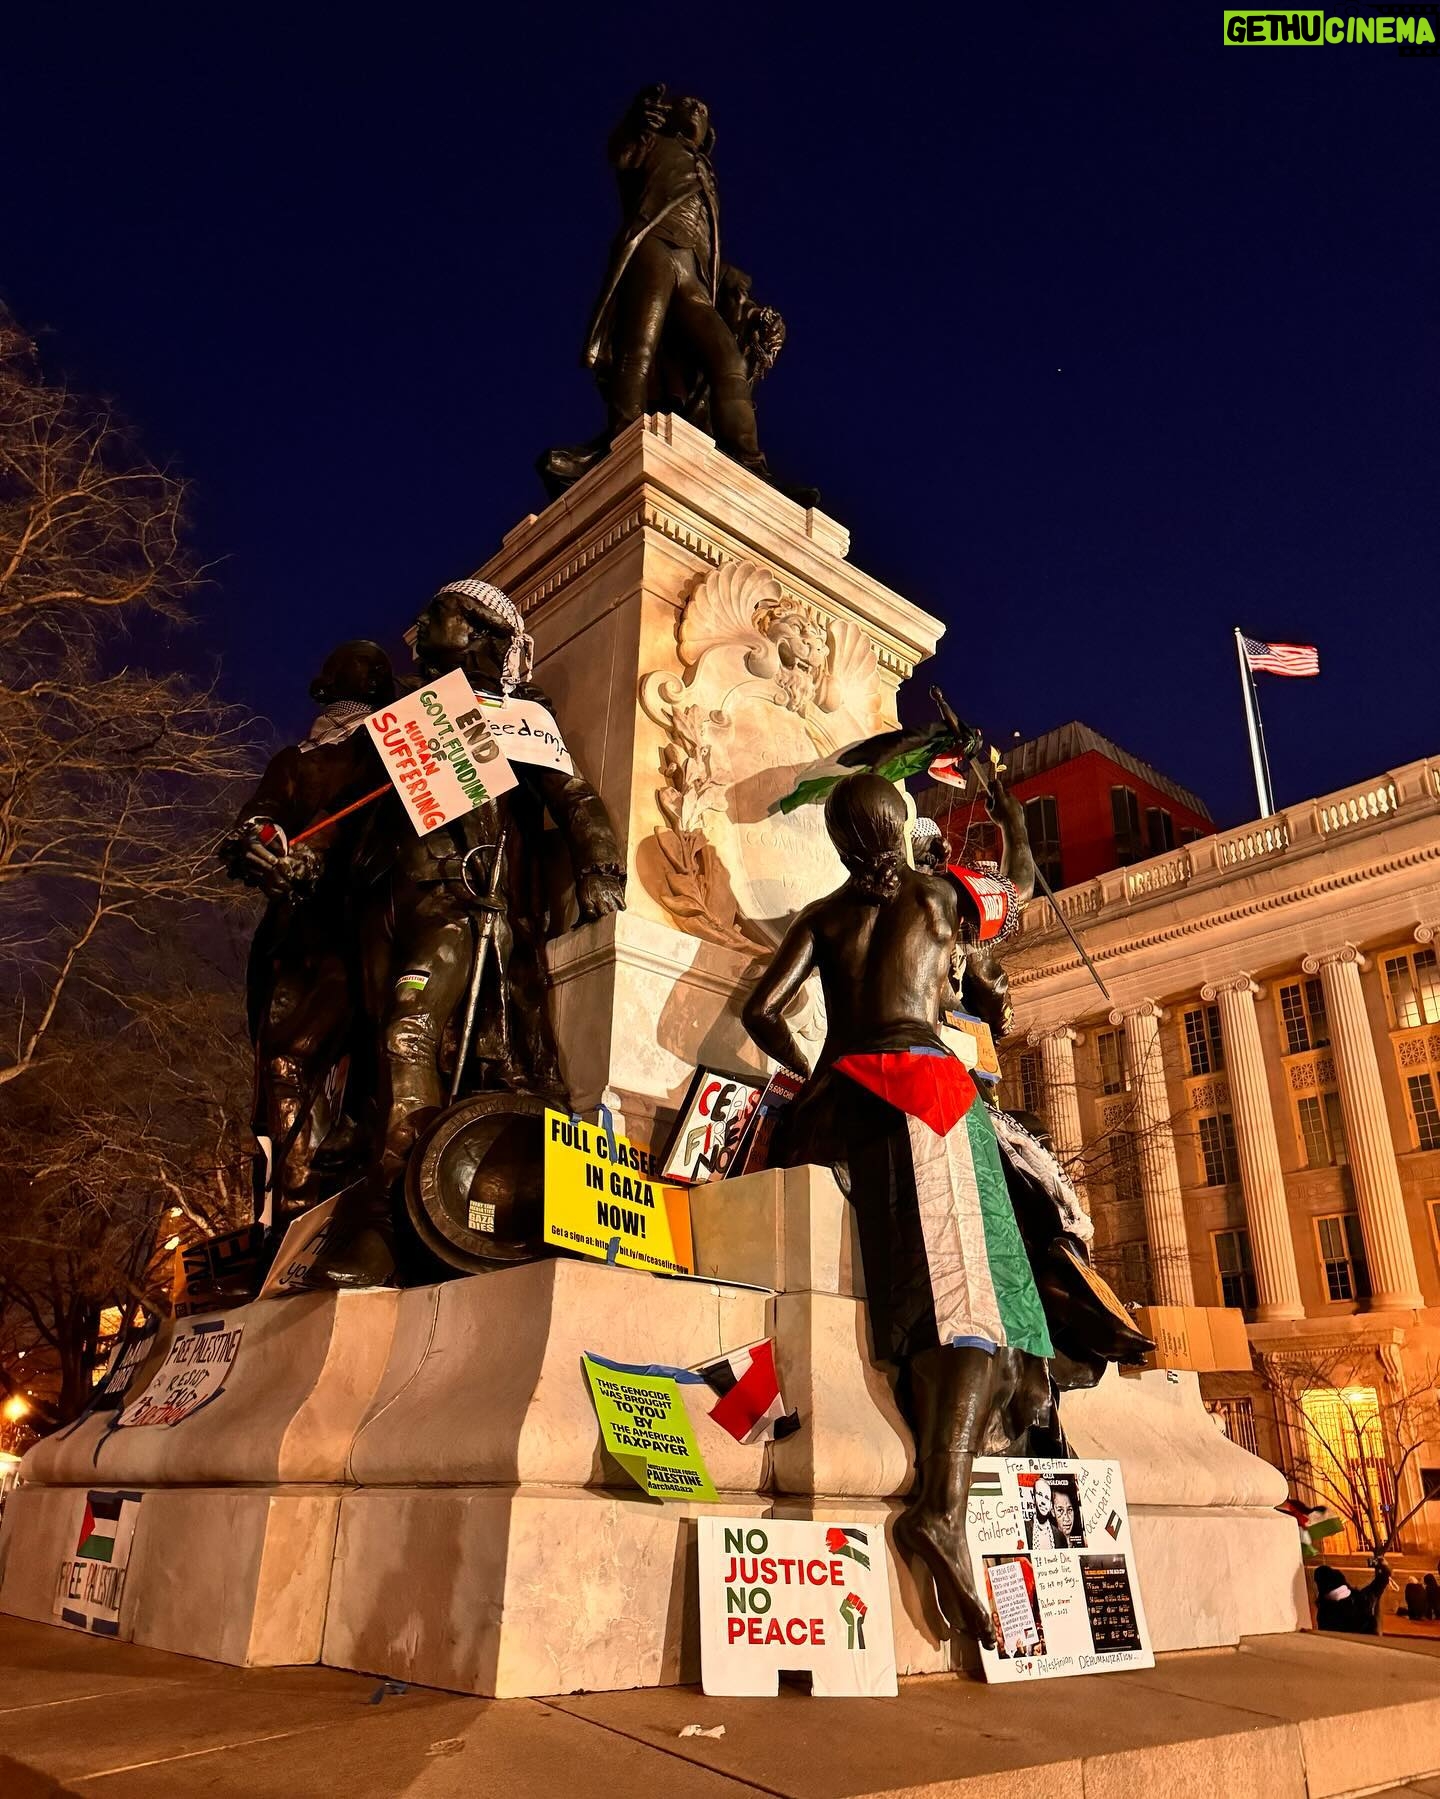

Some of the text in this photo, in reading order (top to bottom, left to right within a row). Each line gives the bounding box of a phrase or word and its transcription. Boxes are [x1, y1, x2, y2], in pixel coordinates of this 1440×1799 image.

[404, 720, 441, 776] HUMAN
[455, 708, 500, 764] END
[428, 738, 448, 762] OF
[372, 712, 447, 830] SUFFERING
[443, 737, 490, 808] FUNDING
[551, 1118, 591, 1154] FULL
[586, 1163, 655, 1208] IN GAZA
[468, 1221, 494, 1233] DIES
[469, 1213, 494, 1225] GAZA
[597, 1200, 646, 1239] NOW!
[551, 1224, 563, 1237] Get
[564, 1229, 569, 1238] a
[570, 1231, 585, 1244] sign
[165, 1334, 195, 1366] FREE
[187, 1329, 242, 1367] PALESTINE
[166, 1369, 210, 1392] RESIST
[596, 1378, 671, 1401] THIS GENOCIDE
[600, 1387, 672, 1410] WAS BROUGHT
[613, 1400, 666, 1420] TO YOU
[610, 1422, 685, 1445] THE AMERICAN
[633, 1416, 653, 1430] BY
[613, 1432, 690, 1457] TAXPAYER
[647, 1469, 703, 1486] PALESTINE
[1005, 1458, 1068, 1474] Free Palestine
[1079, 1466, 1090, 1486] End
[1084, 1479, 1100, 1503] The
[996, 1501, 1019, 1519] Gaza
[724, 1527, 769, 1555] NO
[57, 1561, 87, 1599] FREE
[725, 1557, 845, 1586] JUSTICE
[726, 1587, 772, 1614] NO
[727, 1617, 826, 1646] PEACE
[1015, 1660, 1033, 1676] Stop
